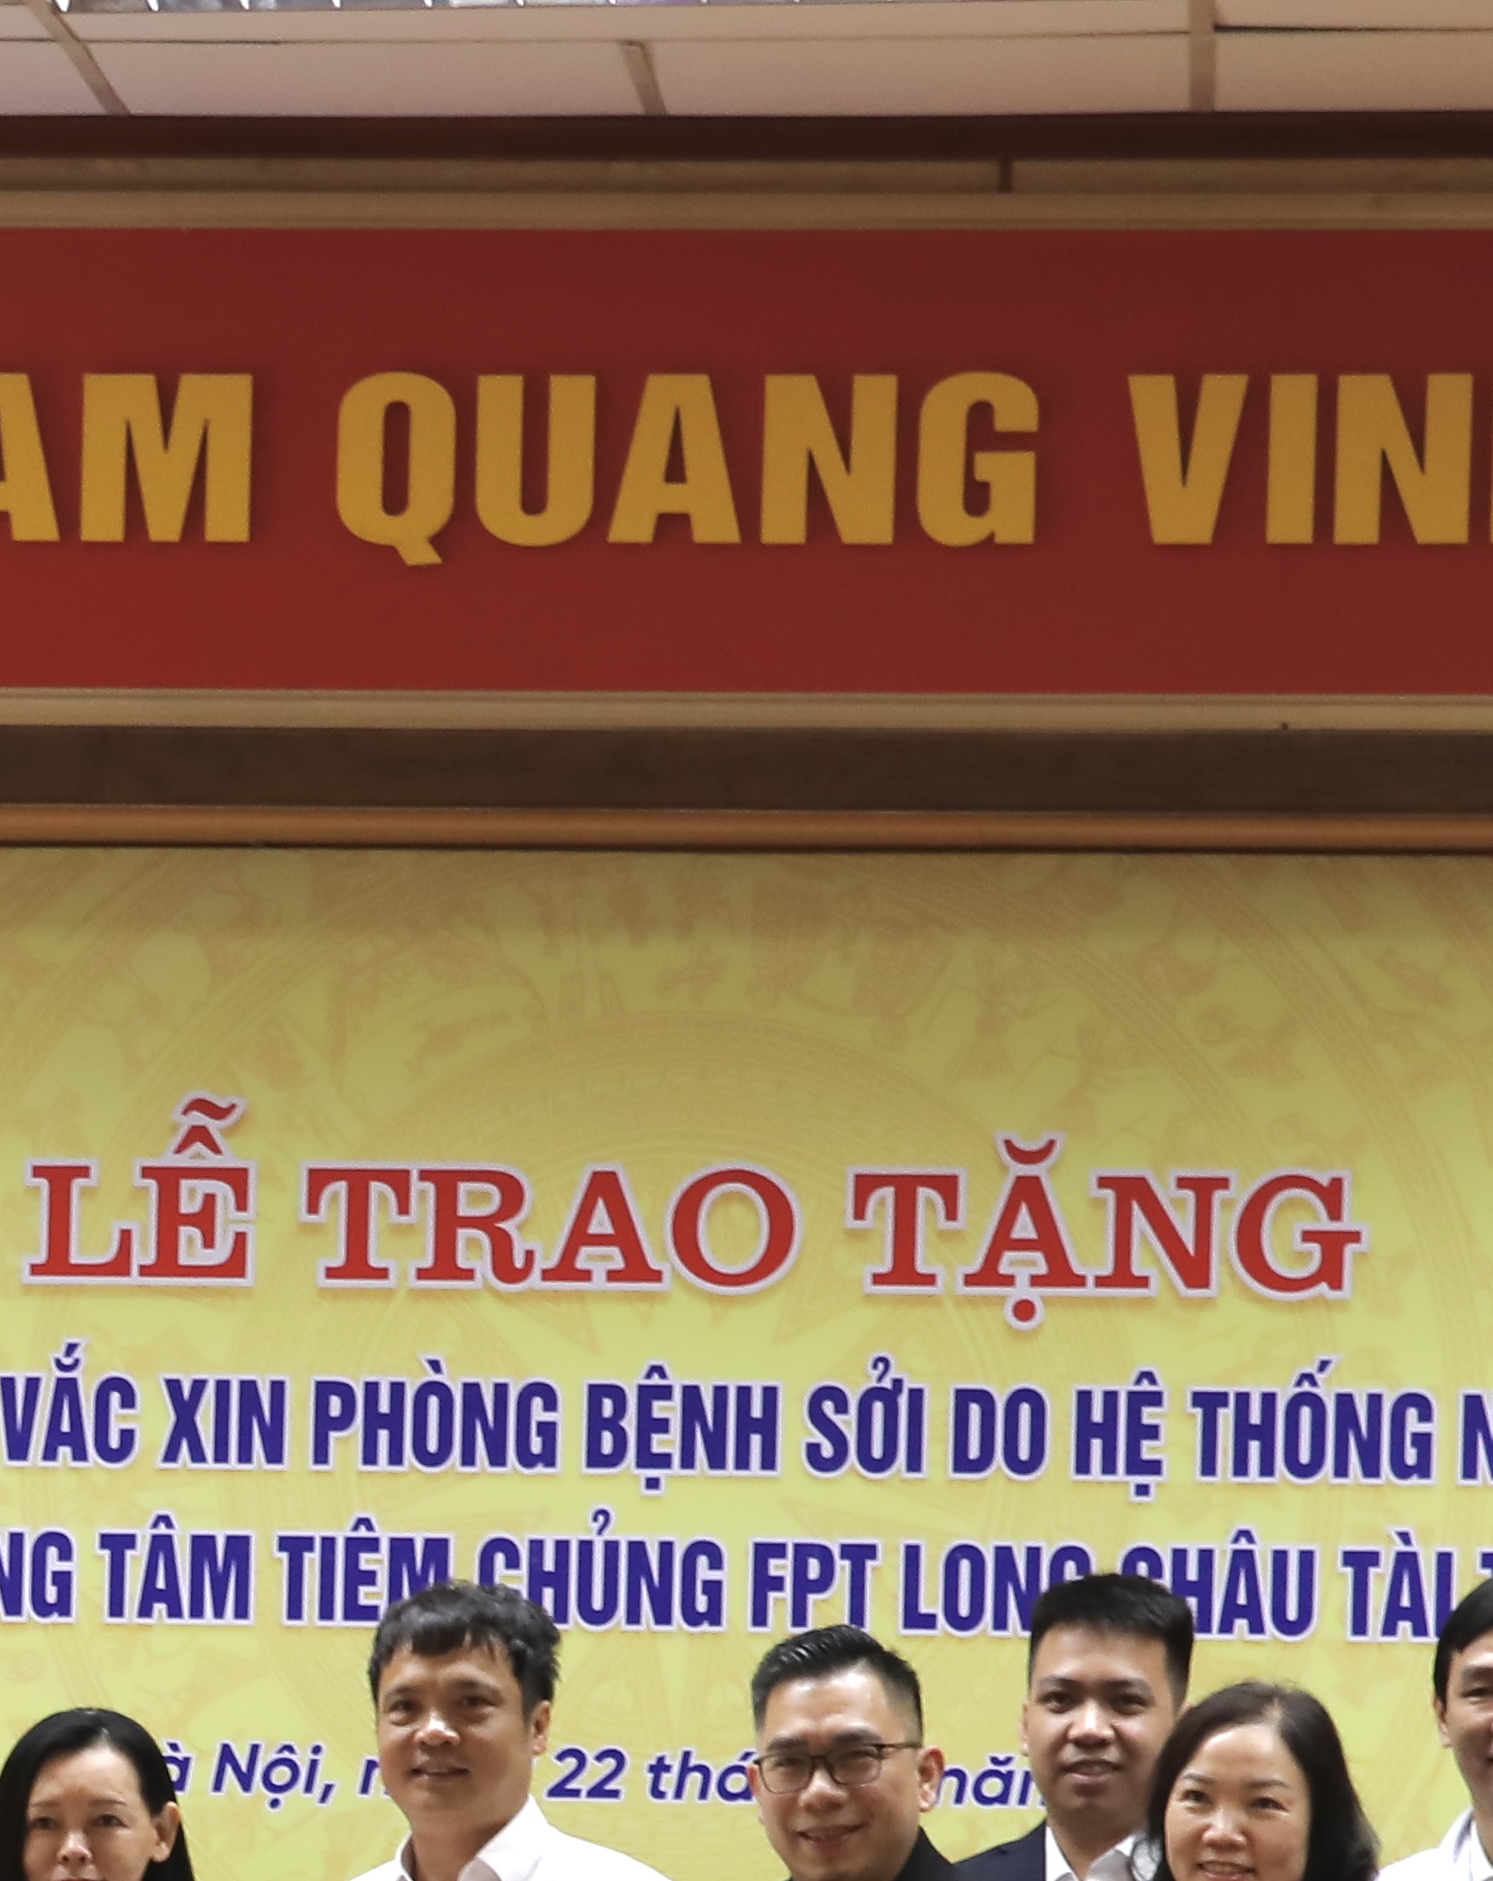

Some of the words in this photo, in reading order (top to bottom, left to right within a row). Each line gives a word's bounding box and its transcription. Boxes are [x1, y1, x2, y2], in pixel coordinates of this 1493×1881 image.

[337, 373, 1037, 564] QUANG
[26, 1096, 250, 1280] LỄ
[307, 1167, 795, 1288] TRAO
[854, 1136, 1364, 1322] TẶNG
[0, 1343, 136, 1463] VẮC
[162, 1379, 285, 1464] XIN
[313, 1359, 558, 1469] PHÒNG
[586, 1365, 778, 1490] BỆNH
[806, 1356, 924, 1473] SỞI
[953, 1388, 1046, 1475] DO
[1075, 1371, 1163, 1496] HỆ
[1191, 1360, 1433, 1480] THỐNG
[100, 1515, 251, 1619] TÂM
[752, 1542, 877, 1629] FPT
[1342, 1532, 1454, 1639] TÀI
[213, 1743, 334, 1808] Nội,
[548, 1748, 625, 1799] 22
[648, 1751, 754, 1801] thá
